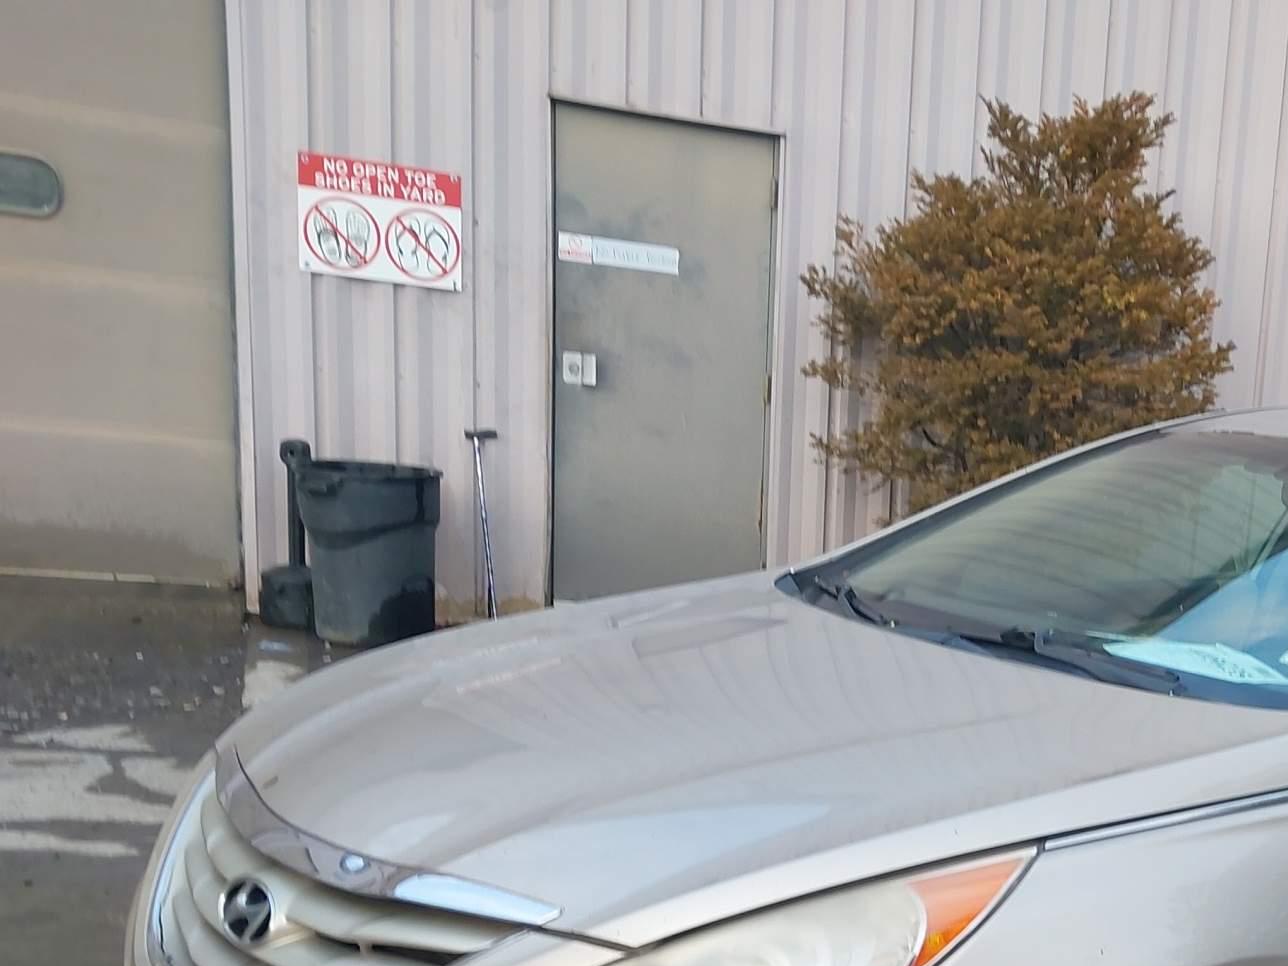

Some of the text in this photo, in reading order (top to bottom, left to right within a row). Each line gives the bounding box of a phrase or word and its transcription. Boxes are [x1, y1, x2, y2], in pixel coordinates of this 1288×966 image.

[314, 171, 446, 205] SHOES IN YARD
[323, 157, 437, 189] NO OPEN TOE
